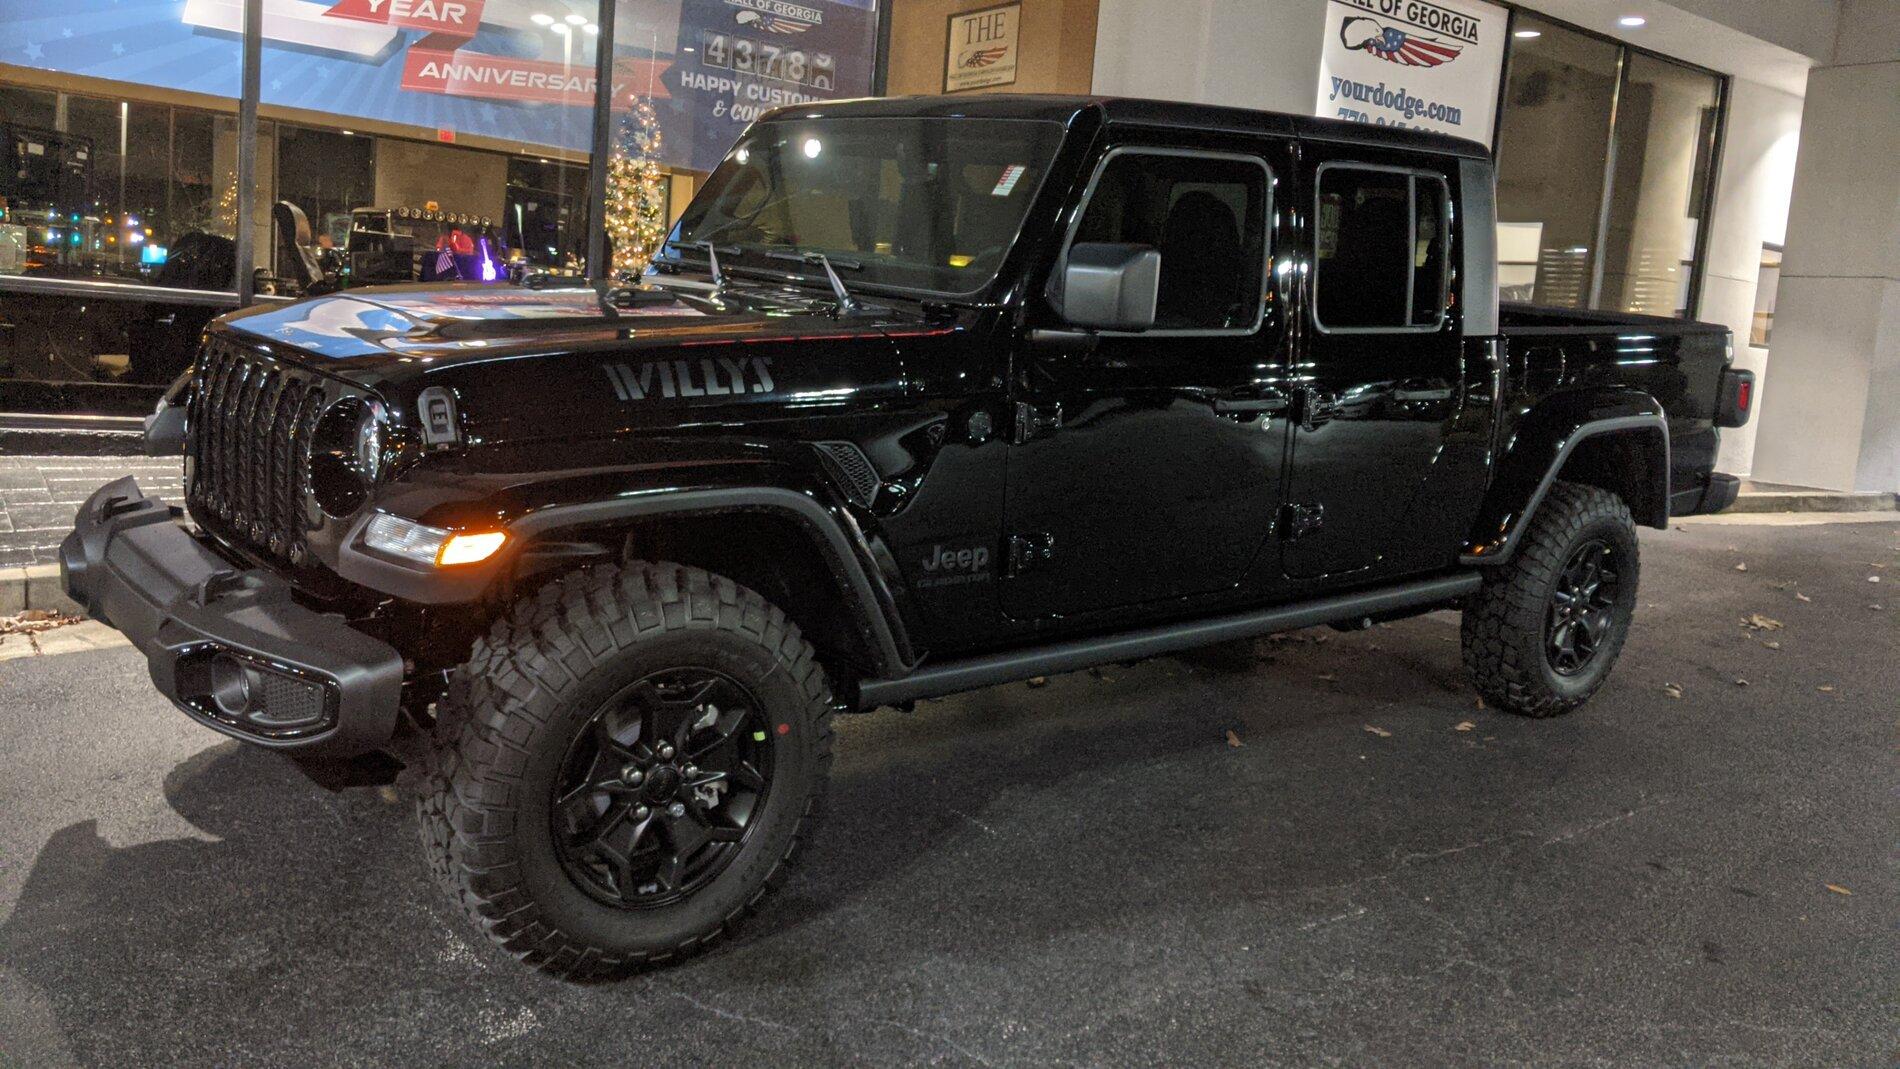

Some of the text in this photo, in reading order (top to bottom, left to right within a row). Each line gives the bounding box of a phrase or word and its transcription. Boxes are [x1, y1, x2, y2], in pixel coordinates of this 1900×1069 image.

[368, 0, 467, 24] YEAR
[773, 4, 823, 22] GEORGIA
[1380, 0, 1479, 41] OF GEORGIA
[964, 12, 1007, 45] THE
[418, 62, 625, 98] ANNIVERSARY
[681, 70, 743, 97] HAPPY
[712, 100, 729, 118] &
[1329, 75, 1462, 126] yourdodge.com
[602, 356, 775, 401] WILLYS
[922, 545, 989, 572] Jeep
